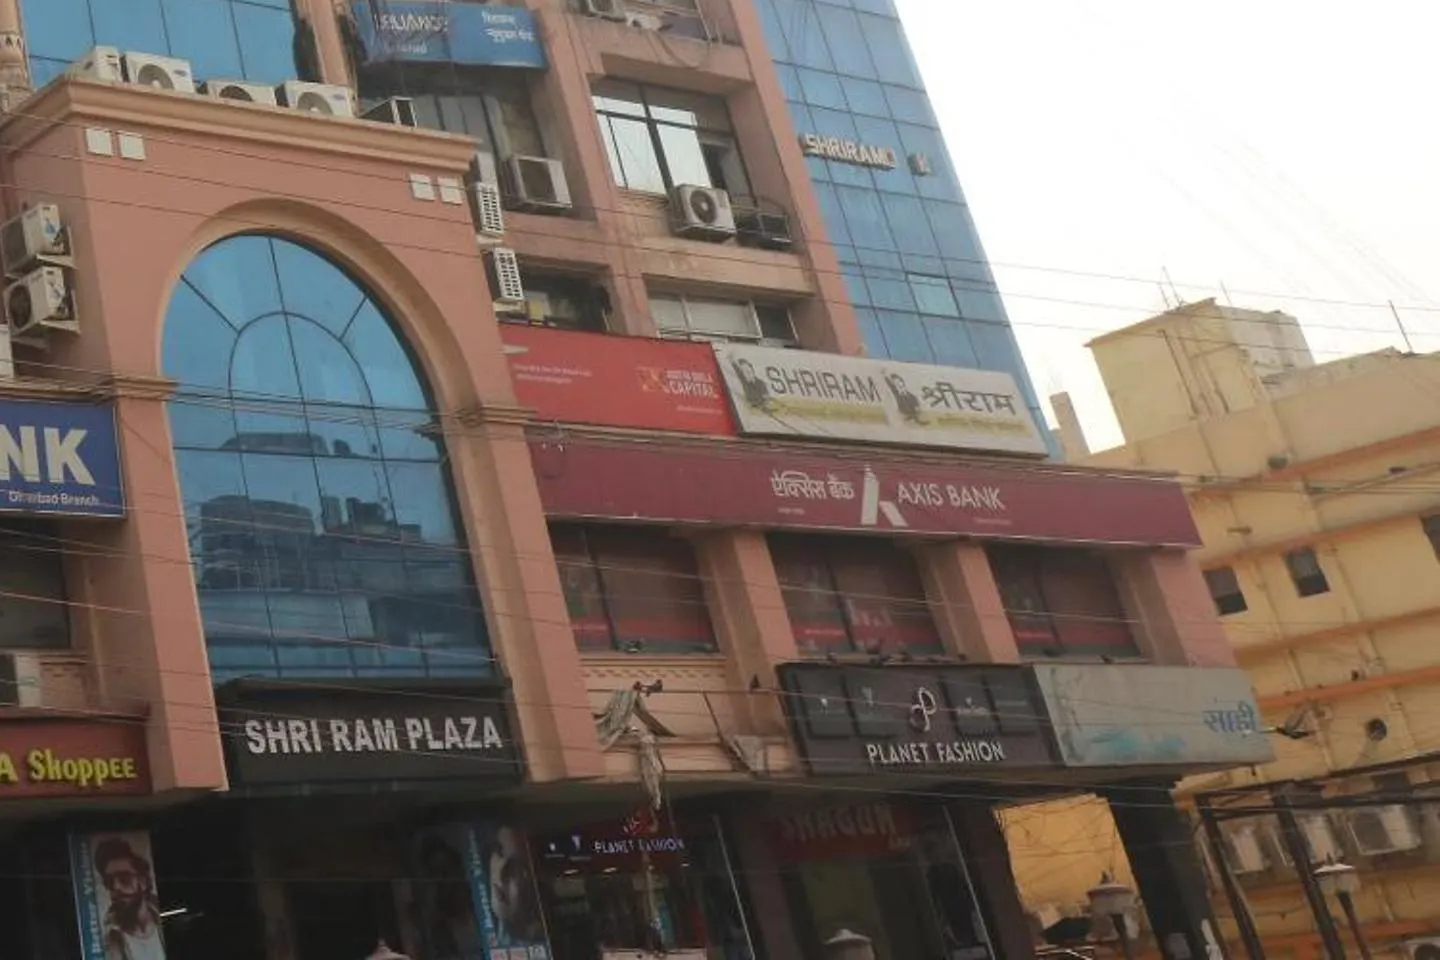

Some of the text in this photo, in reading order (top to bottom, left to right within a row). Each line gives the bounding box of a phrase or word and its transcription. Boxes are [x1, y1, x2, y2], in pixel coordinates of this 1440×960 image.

[765, 366, 882, 403] SHRIRAM
[921, 381, 1016, 416] श्रीराम
[898, 481, 1007, 511] AXIS BANK
[245, 716, 504, 754] SHRI RAM PLAZA
[867, 739, 1007, 765] PLANET FASHION
